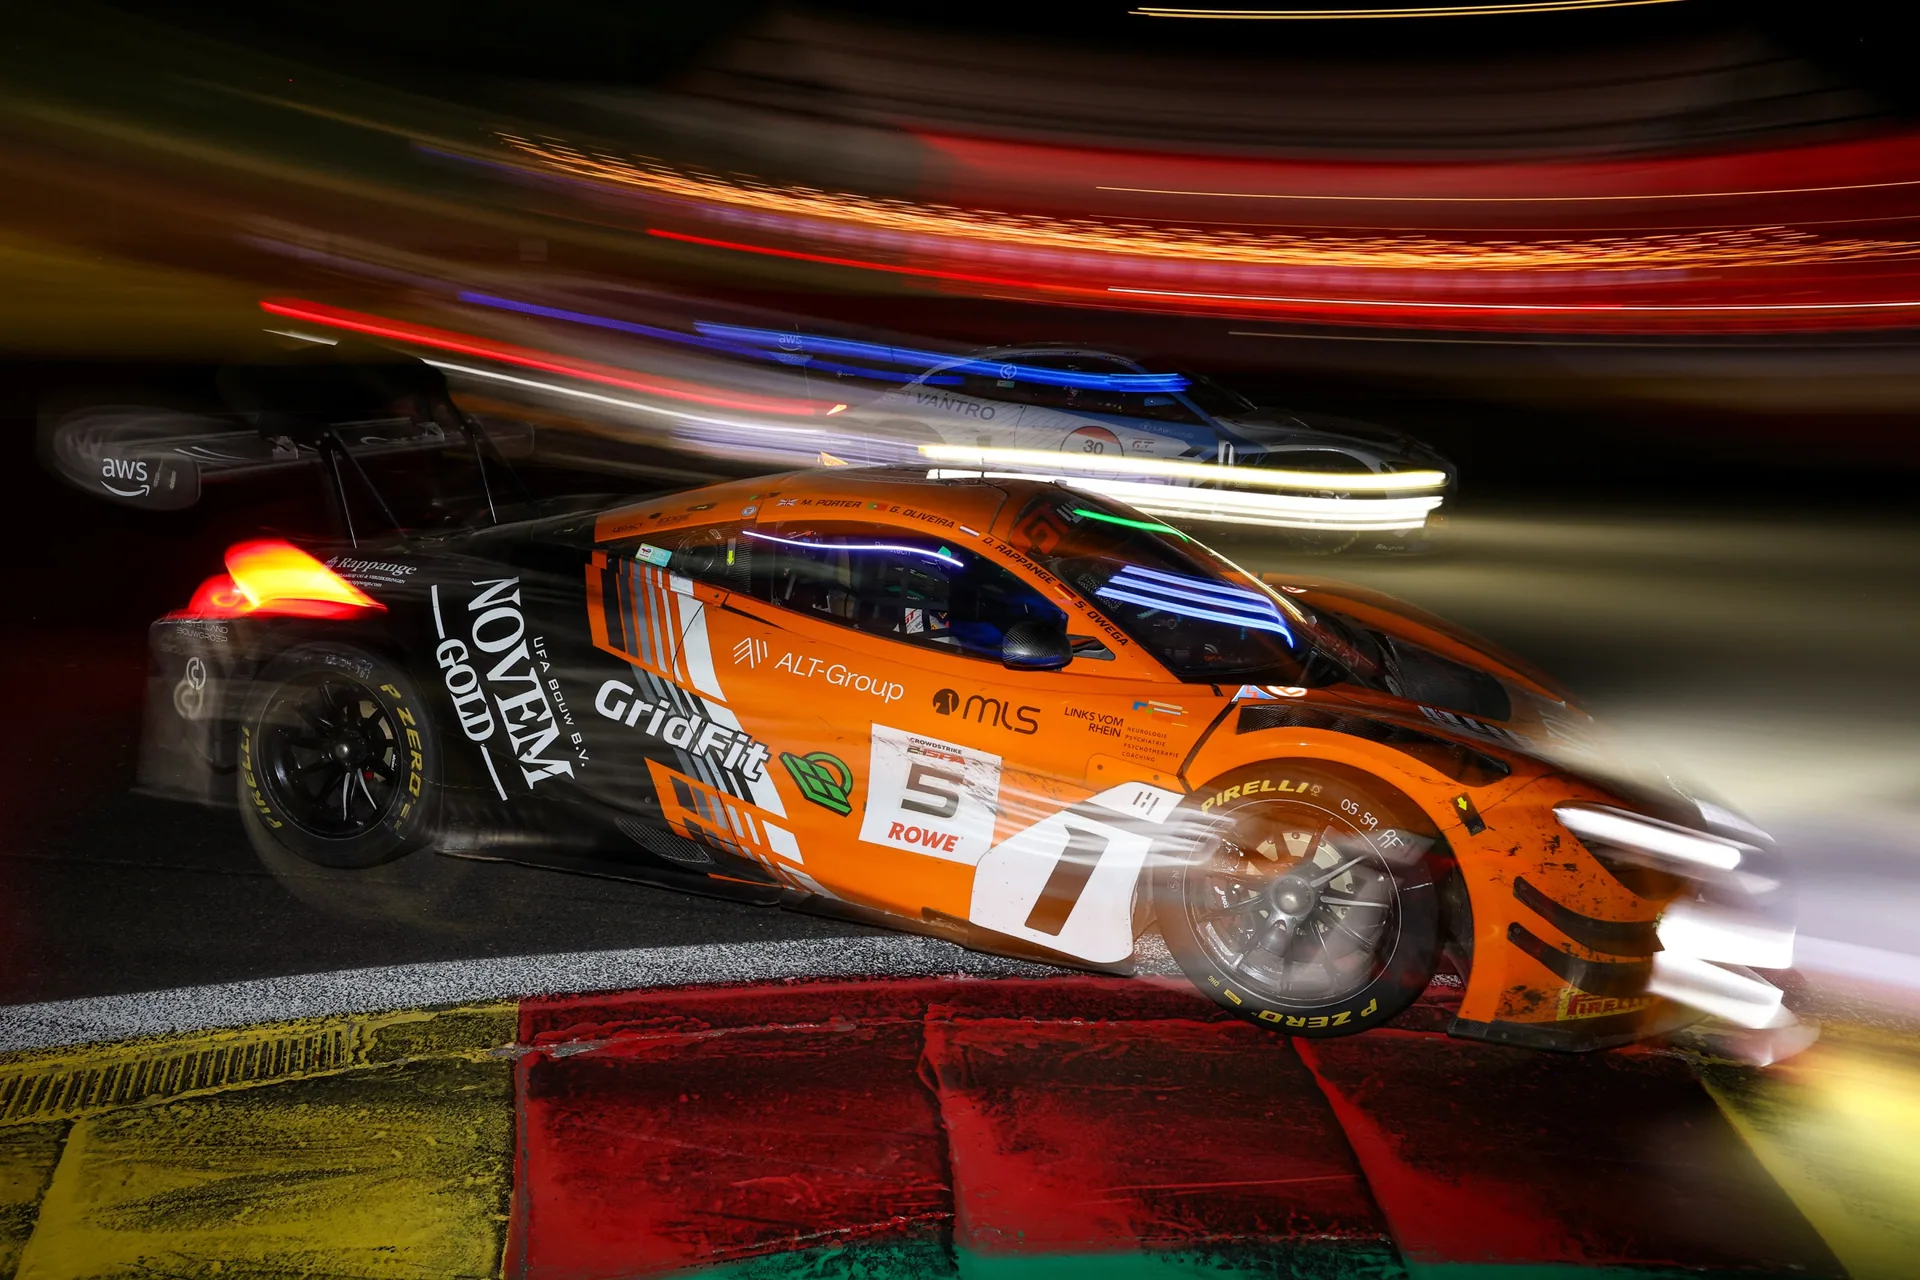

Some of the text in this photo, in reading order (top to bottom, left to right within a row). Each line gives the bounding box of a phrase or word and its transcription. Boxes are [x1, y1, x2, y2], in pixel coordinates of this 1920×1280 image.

[916, 393, 996, 420] VANTRO
[1083, 440, 1104, 455] 30
[101, 456, 148, 482] aws
[816, 499, 863, 508] PORTER
[902, 508, 956, 528] OLIVEIRA
[336, 557, 418, 576] Rappange
[994, 543, 1057, 585] RAPPANGE
[1086, 610, 1129, 646] OWEGA
[436, 638, 495, 742] GOLD
[468, 576, 576, 790] NOVEM
[774, 652, 905, 704] ALT-Group
[533, 636, 590, 768] UFA BOUW B.V.
[1063, 706, 1125, 728] LINKS VOM
[1087, 722, 1123, 738] RHEIN
[594, 679, 771, 782] GridFit
[1124, 734, 1167, 748] PSYCHIATRIE
[1126, 726, 1169, 740] NEUROLOGIE
[396, 706, 424, 799] ZERO
[909, 737, 963, 755] CROWDSTRIKE
[1121, 751, 1156, 763] COACHING
[1122, 742, 1180, 759] PSYCHOTHERAPIE
[239, 724, 284, 830] PIRELLI
[901, 763, 966, 819] 5
[1200, 779, 1310, 816] PIRELLI
[887, 821, 960, 853] ROWE
[1257, 1009, 1353, 1028] ZERO
